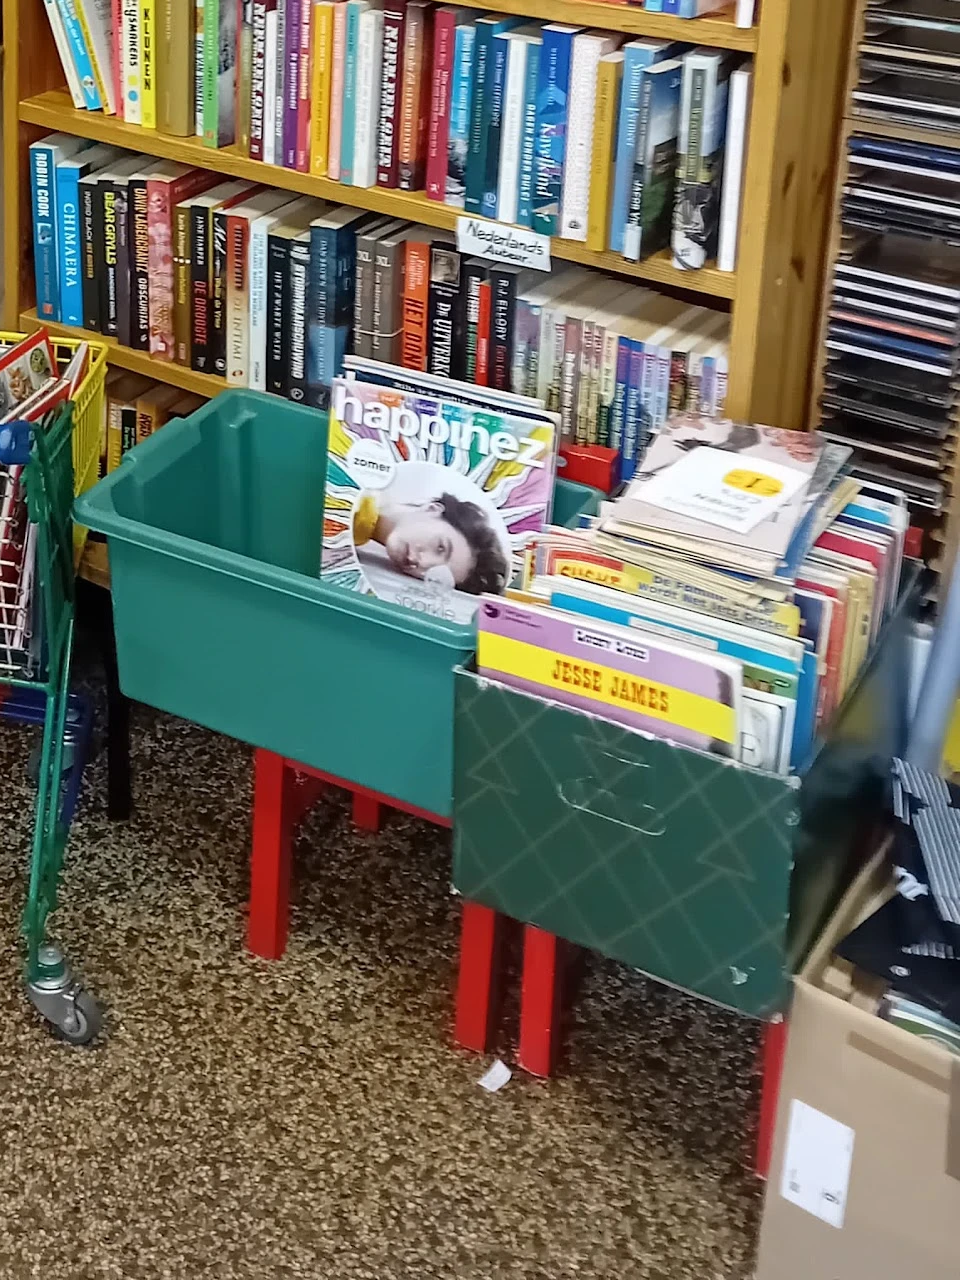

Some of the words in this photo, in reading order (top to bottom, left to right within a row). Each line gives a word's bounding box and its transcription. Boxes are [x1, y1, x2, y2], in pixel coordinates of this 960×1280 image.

[35, 153, 48, 186] ROBIN
[37, 189, 50, 217] COOK
[134, 188, 147, 213] DAVID
[196, 216, 204, 235] JANE
[63, 203, 78, 287] CHIMAERA
[134, 213, 149, 273] LAGERCRANTZ
[196, 236, 204, 265] HARPER
[320, 240, 328, 256] DAN
[194, 280, 206, 294] DE
[274, 271, 283, 295] HET
[498, 279, 508, 298] R.J.
[137, 278, 149, 330] OBSCURITAS
[272, 298, 282, 328] ZWARTE
[194, 297, 207, 345] DROOGTE
[494, 300, 508, 341] ELLORY
[272, 331, 282, 361] WATER
[334, 383, 546, 469] happinez
[353, 455, 392, 473] zomer
[551, 659, 603, 693] JESSE
[609, 671, 670, 713] JAMES
